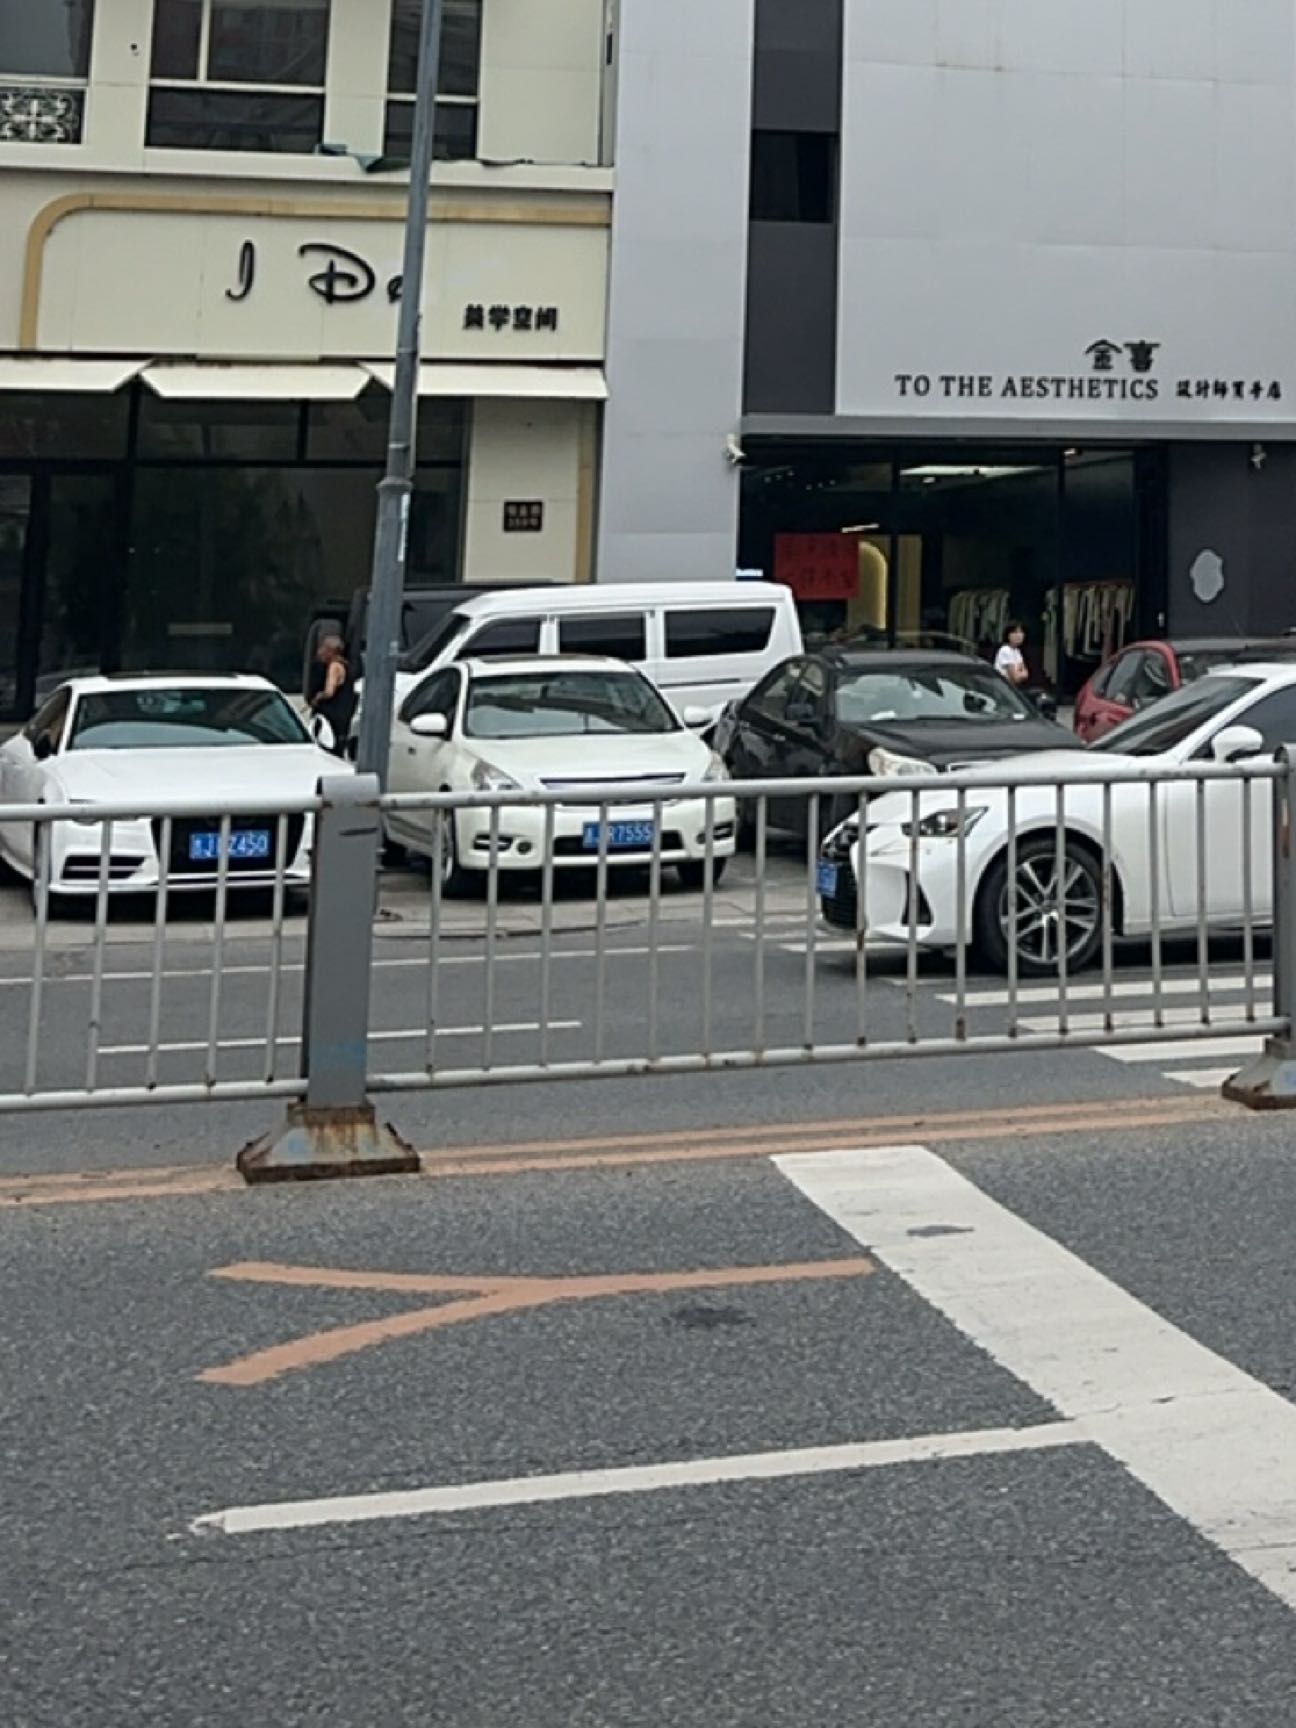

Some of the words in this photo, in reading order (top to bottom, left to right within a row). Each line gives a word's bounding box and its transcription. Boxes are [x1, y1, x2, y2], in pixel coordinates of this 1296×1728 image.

[894, 374, 931, 398] TO
[939, 375, 993, 398] THE
[1000, 375, 1160, 400] AESTHETICS
